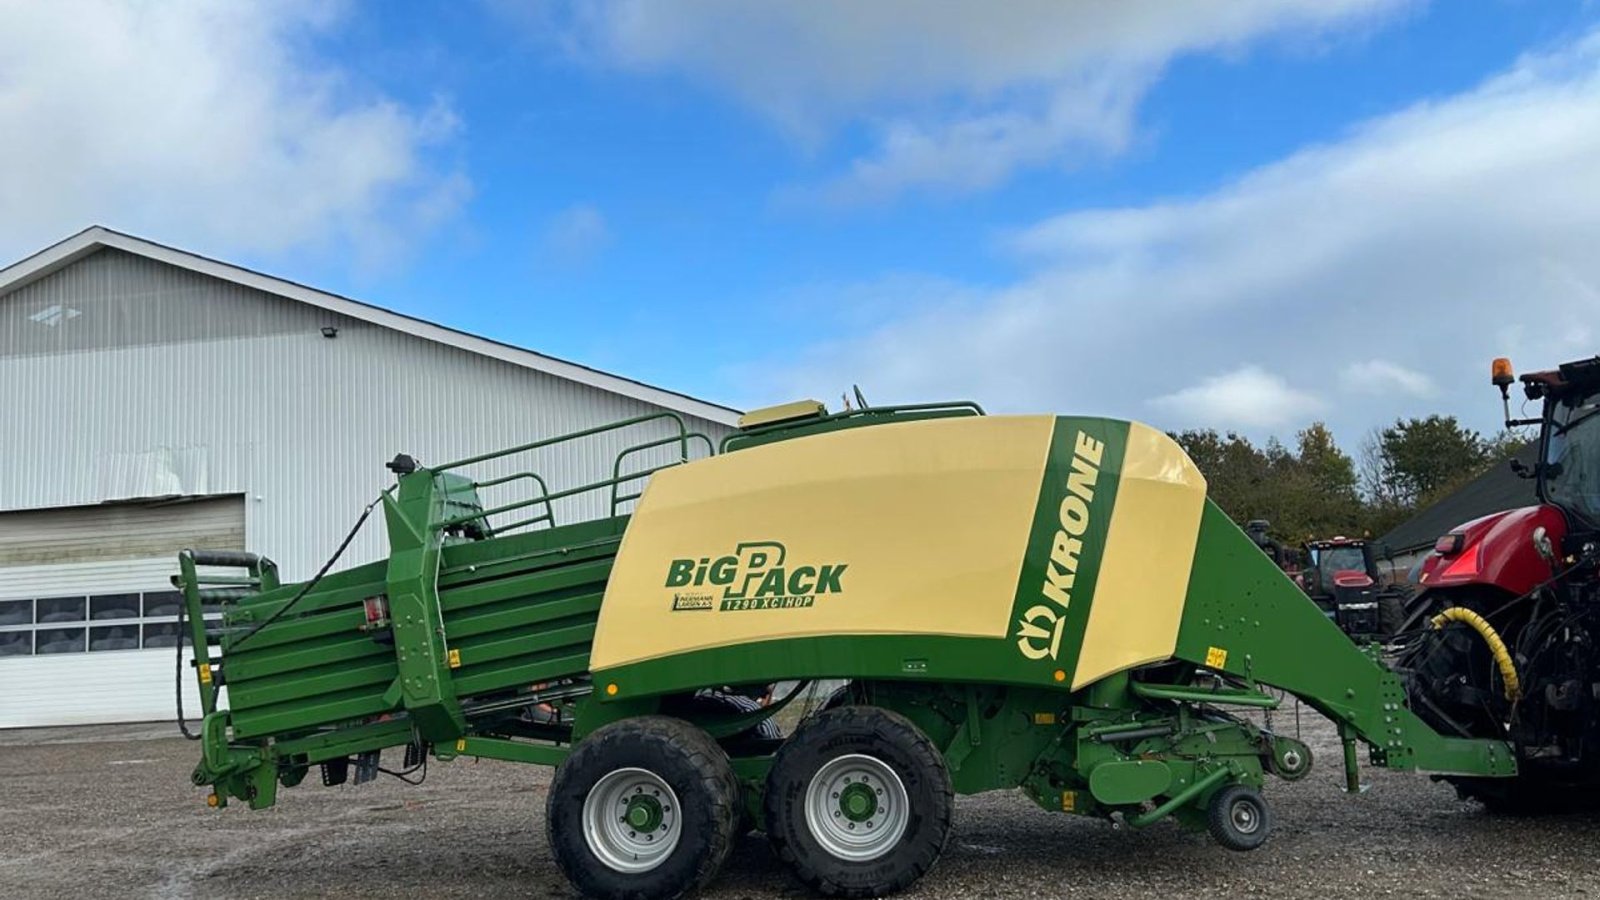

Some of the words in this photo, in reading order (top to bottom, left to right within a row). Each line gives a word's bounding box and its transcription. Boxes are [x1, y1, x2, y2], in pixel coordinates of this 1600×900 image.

[1042, 430, 1104, 609] KRONE
[723, 541, 848, 599] PACK
[726, 600, 758, 610] 1290
